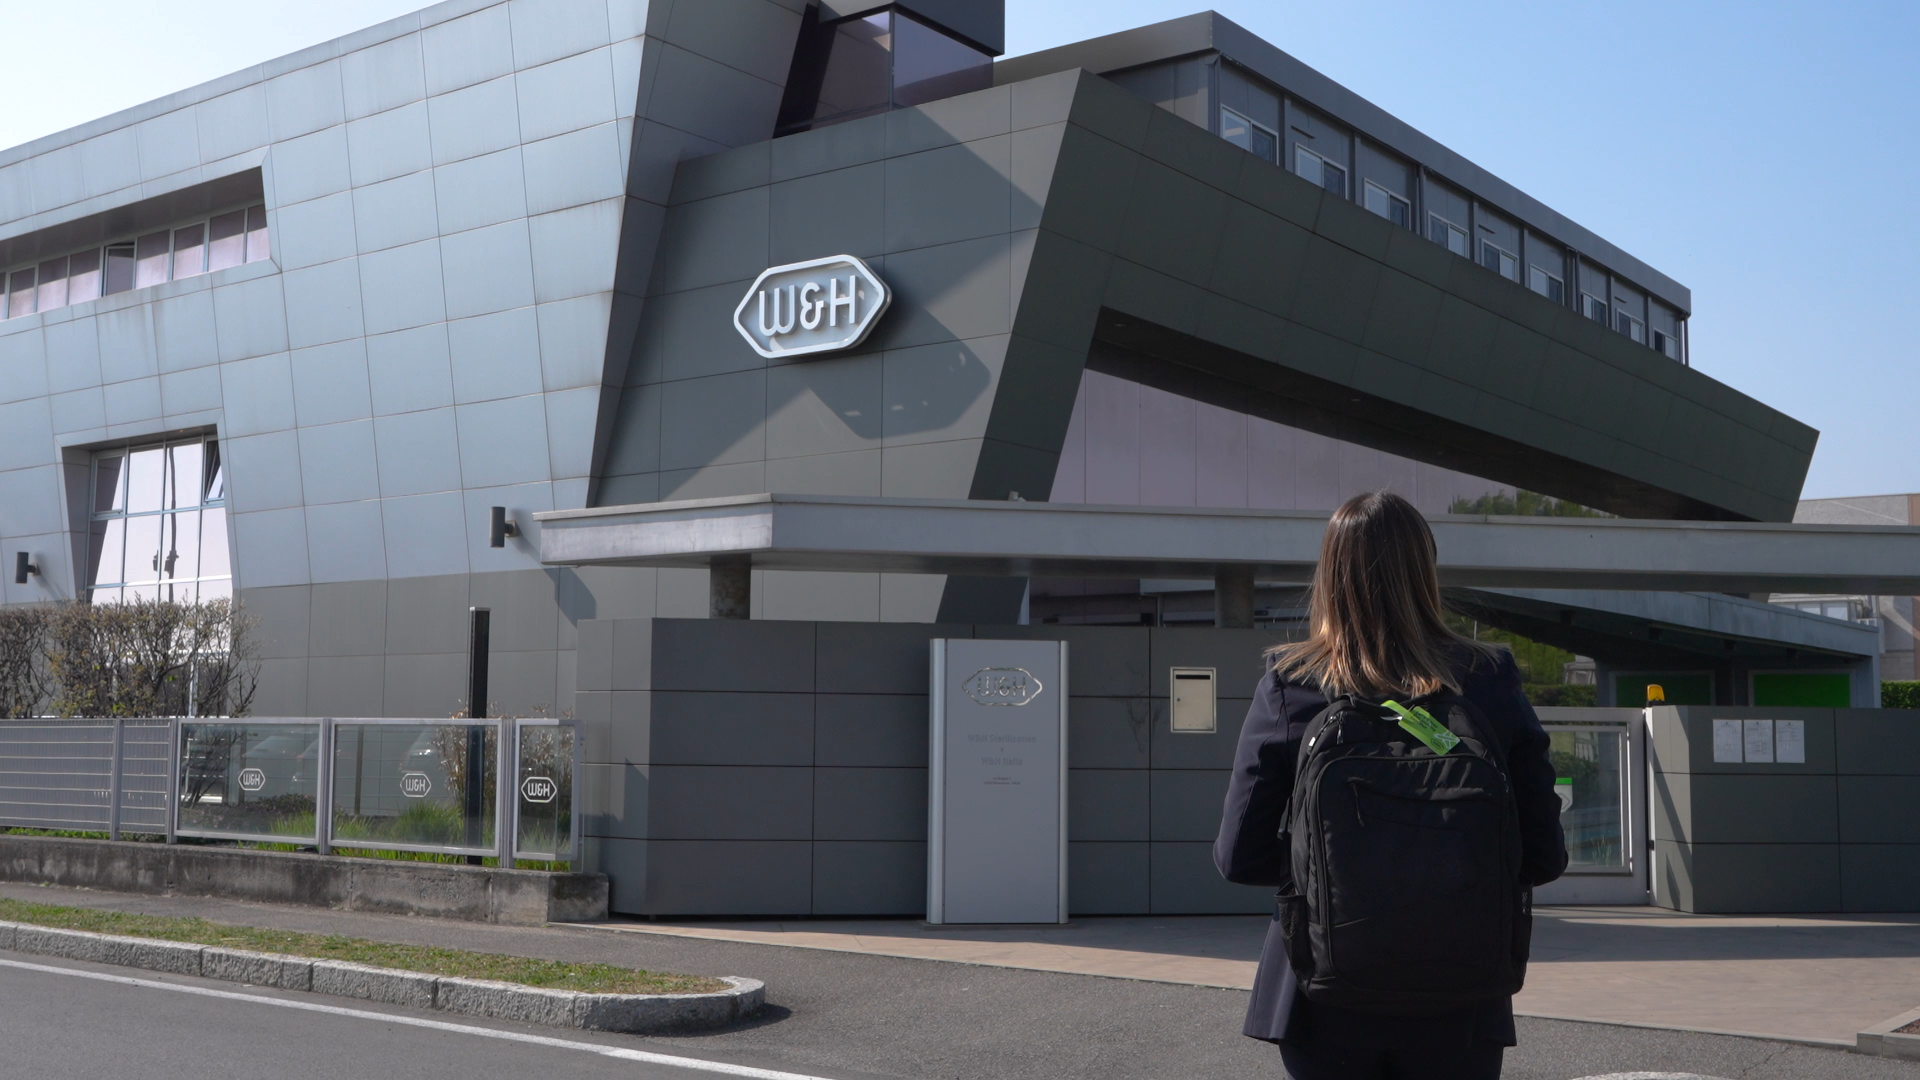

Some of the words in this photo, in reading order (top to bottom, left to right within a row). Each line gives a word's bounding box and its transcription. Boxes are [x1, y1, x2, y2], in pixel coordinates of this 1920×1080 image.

[759, 275, 857, 337] W&H
[977, 676, 1027, 697] W&H
[968, 734, 988, 743] W&H
[989, 734, 1037, 743] Sterilization
[981, 757, 1001, 766] W&H
[1003, 757, 1023, 766] Italia
[243, 773, 261, 786] W&H
[405, 779, 426, 792] W&H
[527, 783, 551, 797] W&H
